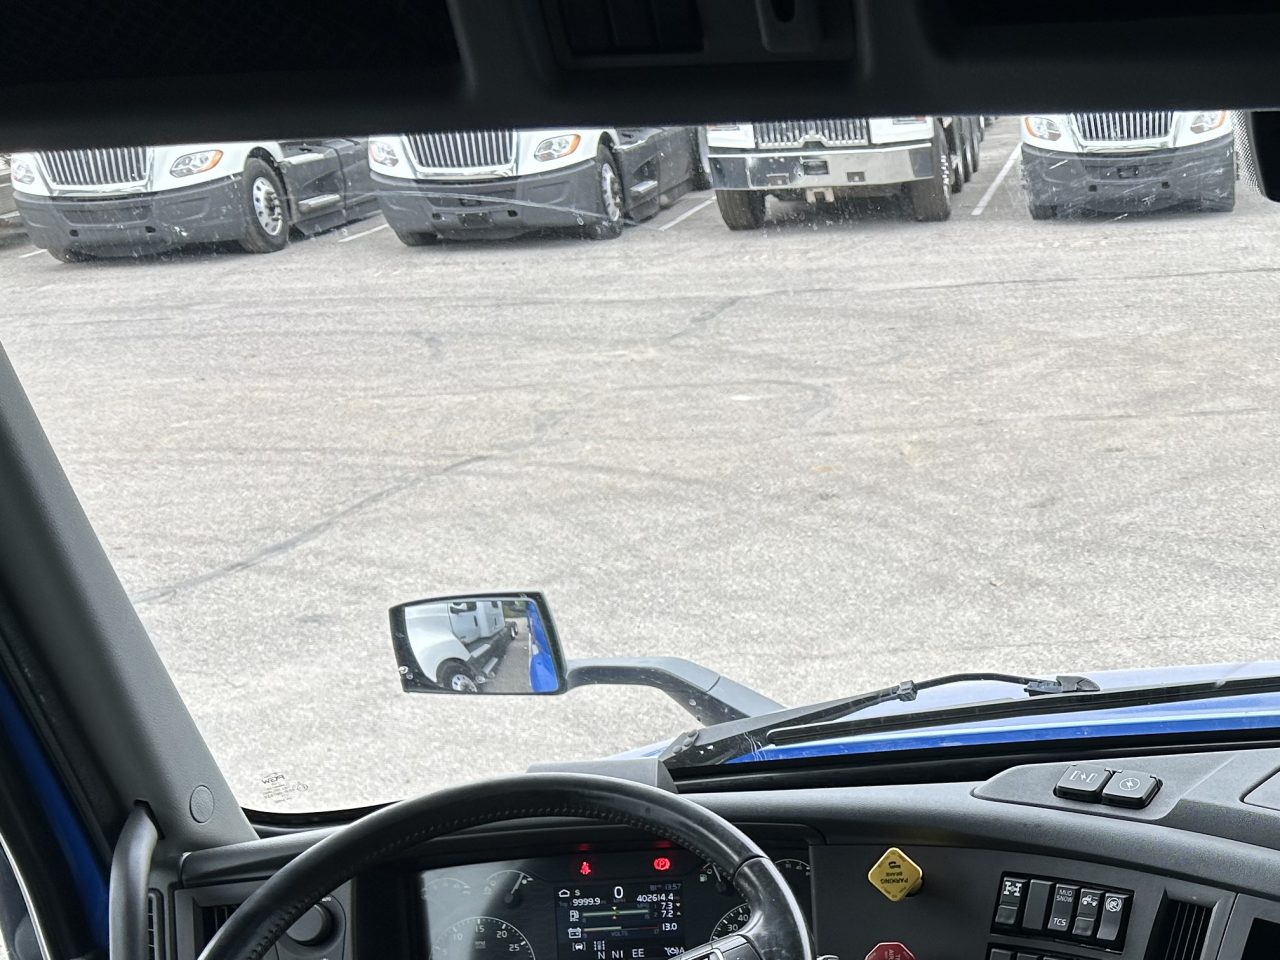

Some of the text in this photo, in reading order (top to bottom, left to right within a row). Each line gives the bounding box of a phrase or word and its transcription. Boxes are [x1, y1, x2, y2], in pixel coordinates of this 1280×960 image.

[613, 886, 624, 899] 0
[1059, 889, 1073, 897] MUD
[636, 892, 674, 902] 402614.4
[1056, 895, 1073, 903] SNOW
[572, 897, 601, 906] 9999.9
[660, 902, 674, 910] 7.3
[660, 910, 674, 918] 7.2
[737, 914, 749, 922] 40
[1053, 917, 1067, 926] TCS
[662, 922, 678, 931] 13.0
[727, 924, 739, 932] 30
[496, 930, 508, 938] 20
[508, 944, 520, 952] 25
[632, 948, 645, 958] EE
